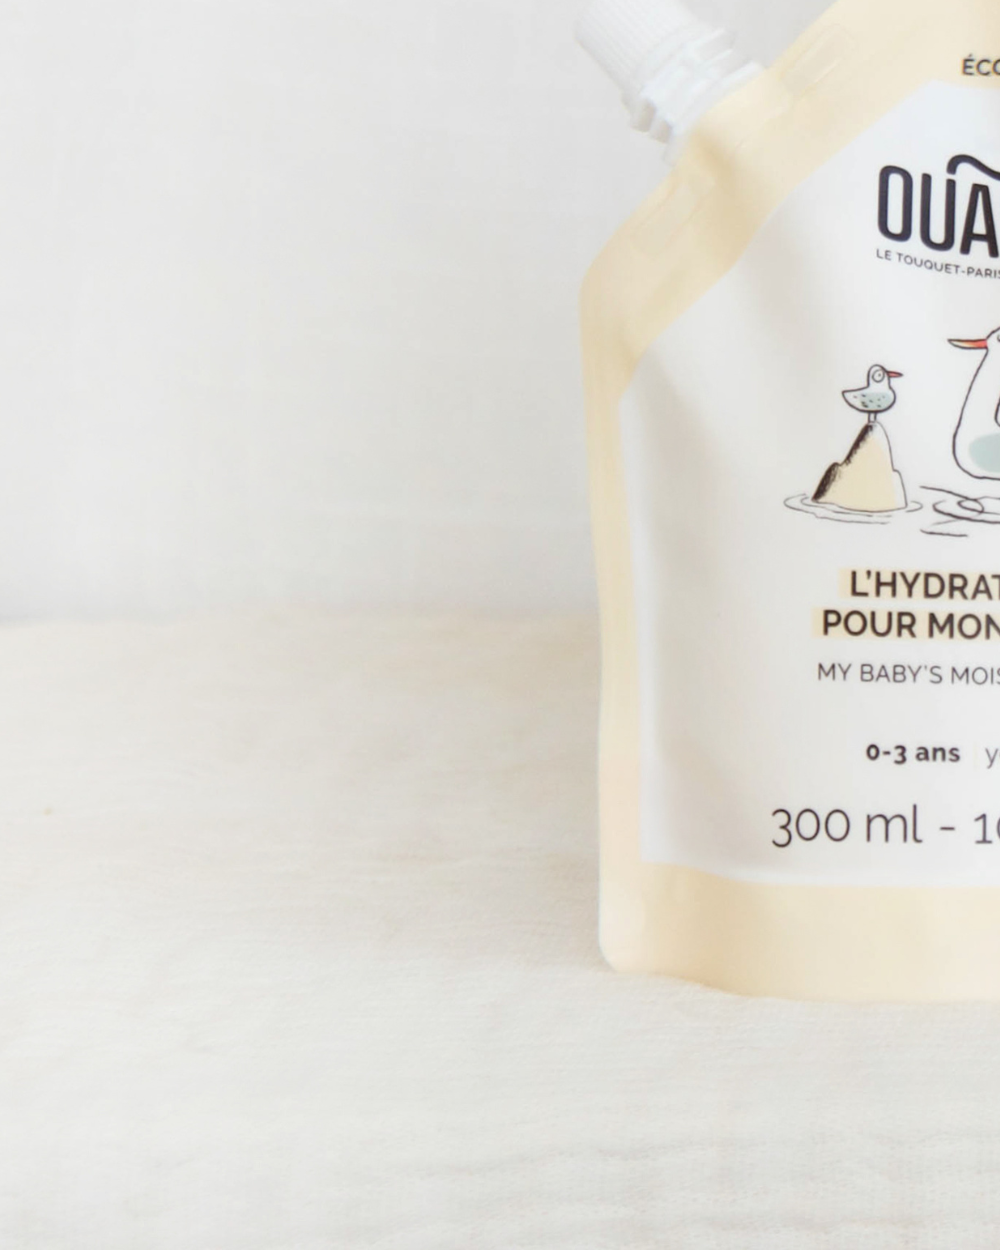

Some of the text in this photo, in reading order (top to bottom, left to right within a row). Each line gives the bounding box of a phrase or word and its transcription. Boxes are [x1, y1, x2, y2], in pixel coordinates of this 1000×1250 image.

[875, 248, 892, 262] LE
[823, 609, 917, 638] POUR
[818, 662, 852, 682] MY
[860, 663, 943, 684] BABY'S
[866, 743, 907, 764] 0-3
[915, 746, 961, 763] ans
[771, 808, 851, 848] 300
[866, 803, 923, 844] ml
